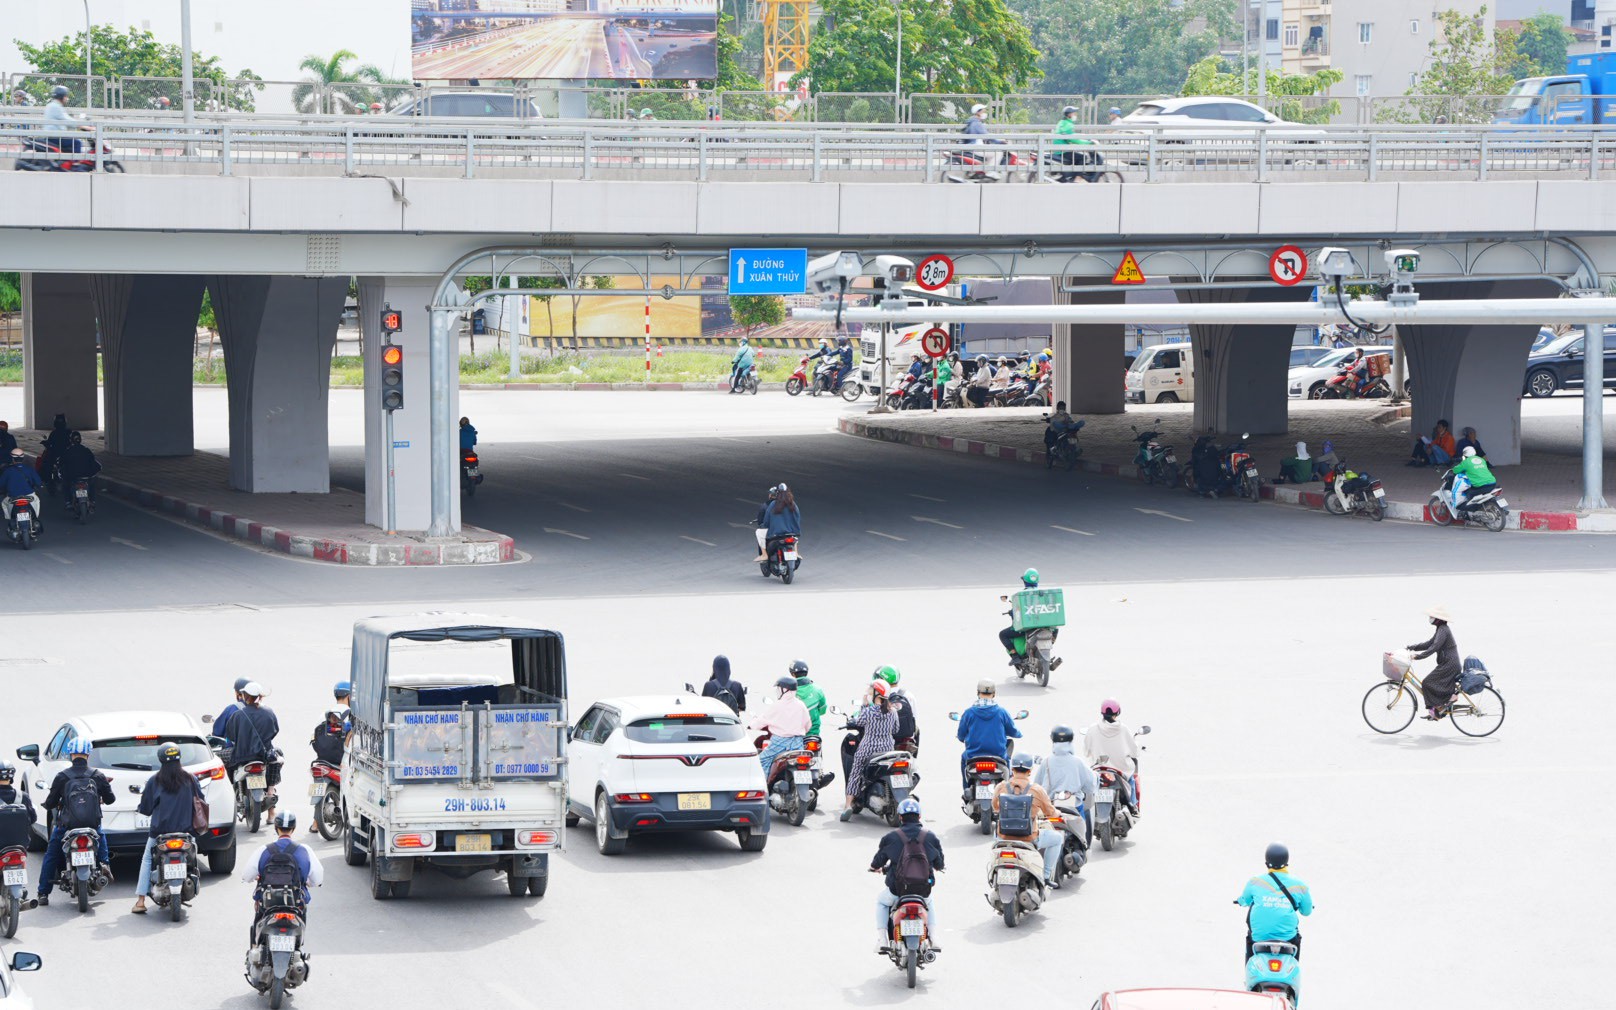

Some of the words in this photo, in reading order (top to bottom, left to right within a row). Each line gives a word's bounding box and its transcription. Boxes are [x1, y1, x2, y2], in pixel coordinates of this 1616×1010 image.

[753, 257, 784, 268] ĐƯỜNG
[750, 272, 773, 282] XUÂN
[777, 270, 800, 282] THỦY
[1024, 603, 1061, 615] XFAST
[415, 767, 424, 776] 03
[424, 766, 441, 776] 5454
[442, 765, 458, 775] 2829
[506, 764, 522, 774] 0977
[523, 763, 540, 773] 0000
[540, 763, 549, 773] 59
[444, 798, 506, 812] 29H-803.14
